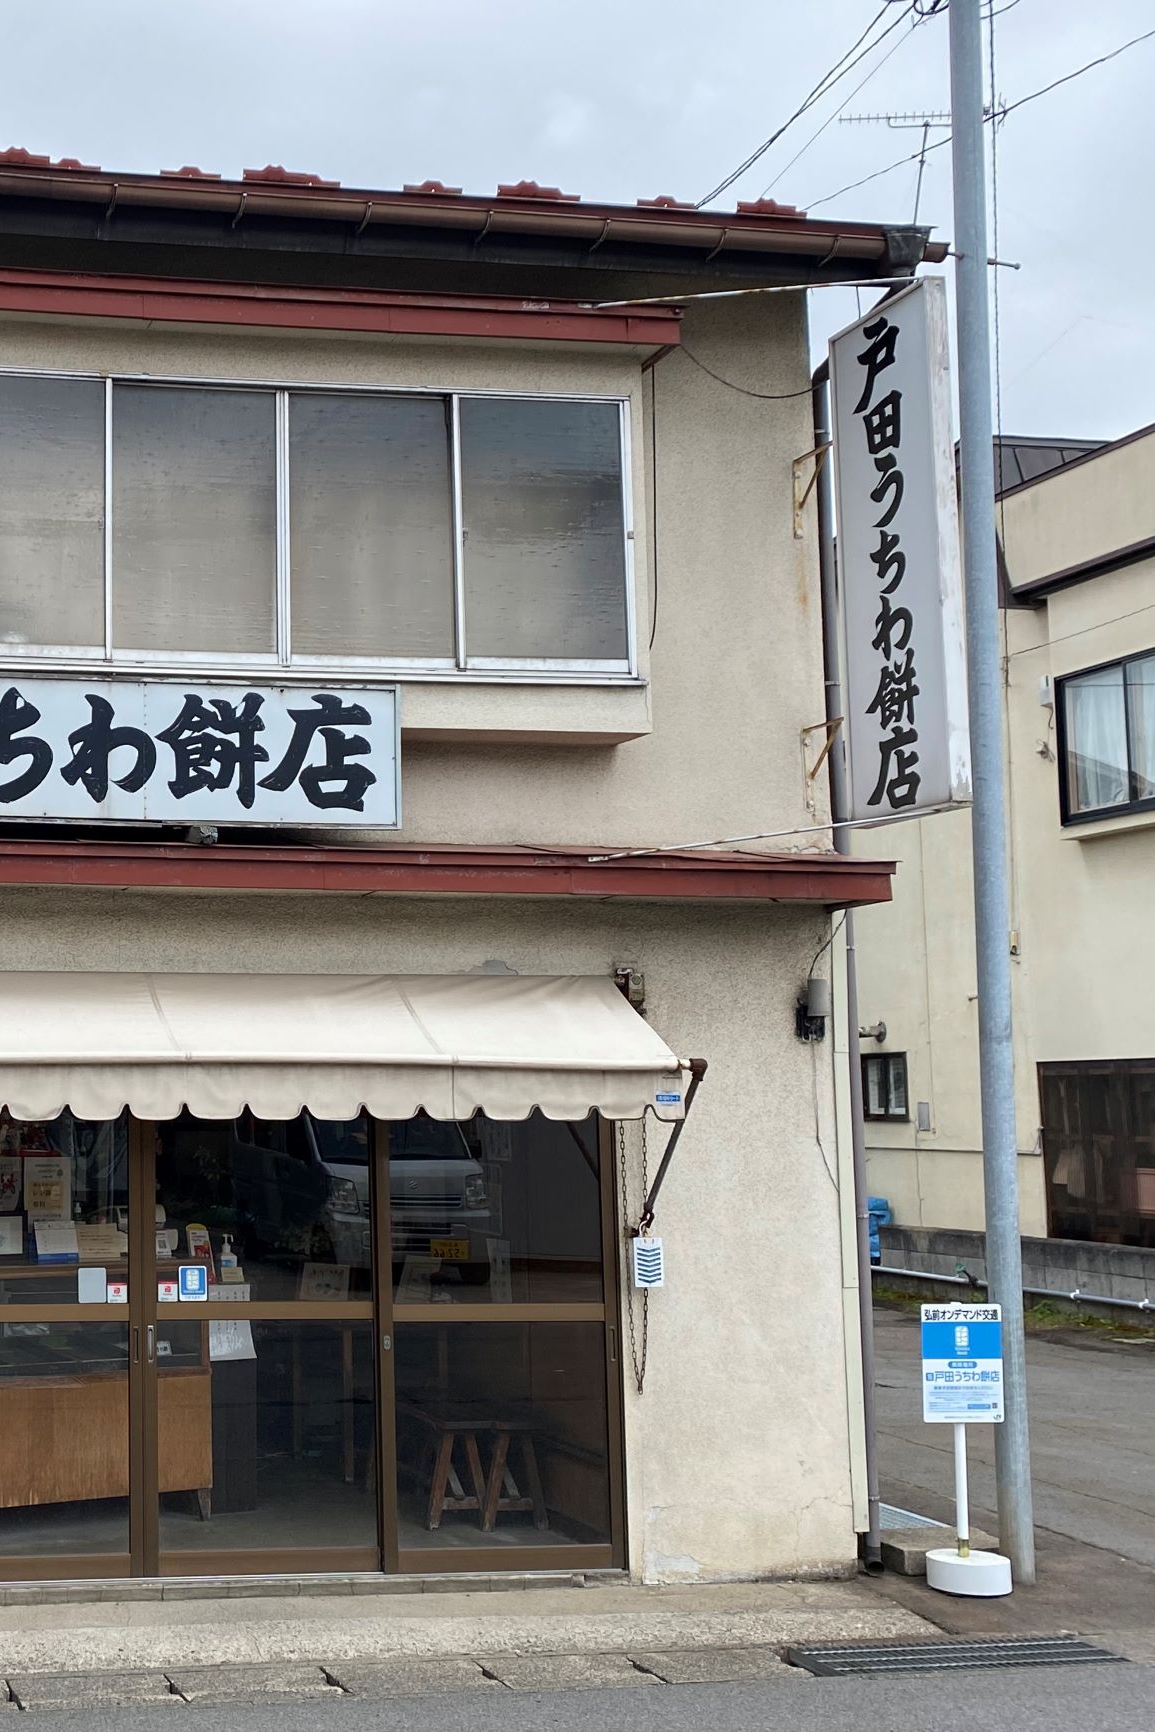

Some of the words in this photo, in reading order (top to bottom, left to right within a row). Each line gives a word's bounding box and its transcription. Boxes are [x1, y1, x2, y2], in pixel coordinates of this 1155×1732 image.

[853, 316, 920, 810] 戸田うちわ餅店
[924, 1309, 998, 1320] 弘前オンデマンド交通
[934, 1371, 1000, 1382] 戸田うちわ餅店
